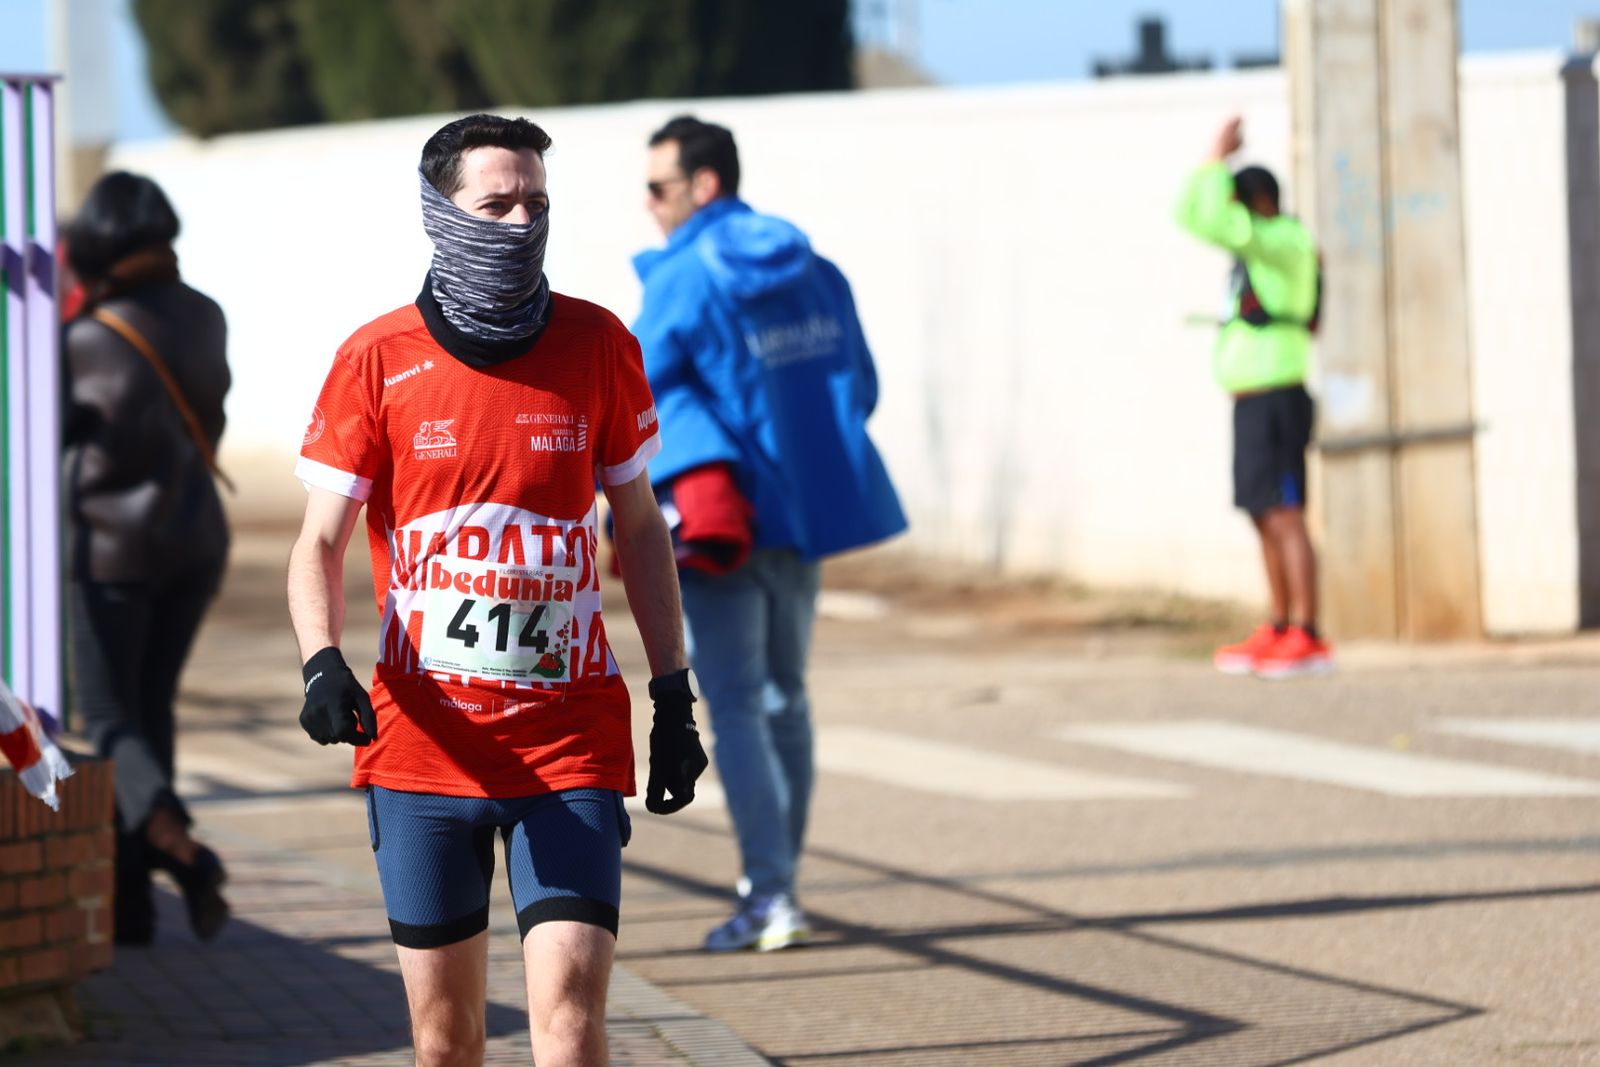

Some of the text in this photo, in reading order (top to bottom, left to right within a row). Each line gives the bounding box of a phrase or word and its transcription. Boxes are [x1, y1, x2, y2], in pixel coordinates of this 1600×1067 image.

[383, 364, 420, 387] luanvi
[529, 413, 574, 425] GENERALI
[636, 402, 657, 432] AQU
[415, 448, 458, 460] GENERALI
[530, 433, 576, 452] MÁLAGA
[430, 562, 574, 603] bedunia
[446, 598, 549, 655] 414
